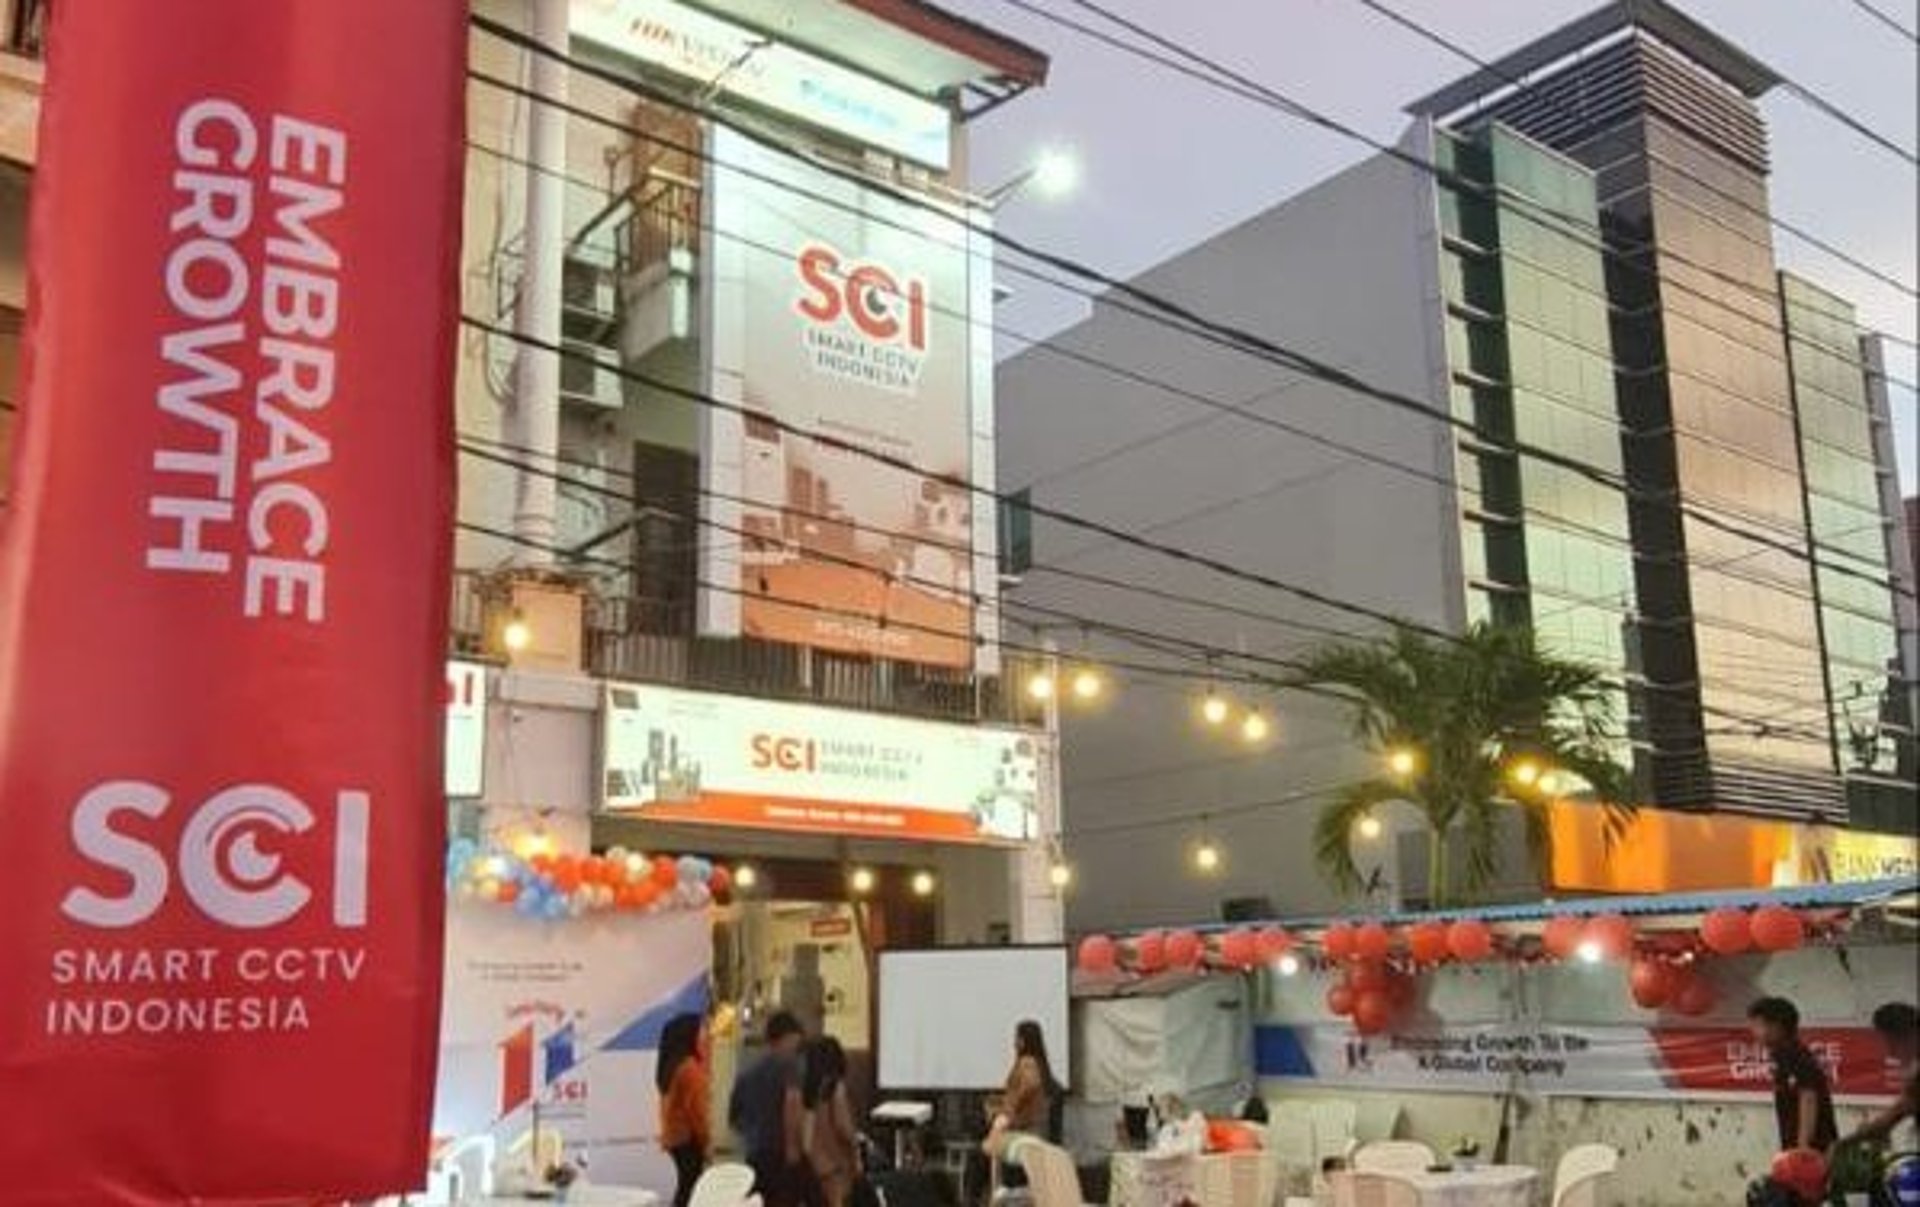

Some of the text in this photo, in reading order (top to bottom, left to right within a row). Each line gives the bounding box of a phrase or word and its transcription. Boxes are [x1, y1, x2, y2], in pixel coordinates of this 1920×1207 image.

[146, 99, 258, 573] GROWTH
[799, 245, 925, 351] SCI
[243, 114, 347, 622] EMBRACE
[751, 734, 816, 773] SCI
[60, 780, 370, 929] SCI
[46, 996, 310, 1034] INDONESIA
[52, 948, 366, 984] SMART CCTV
